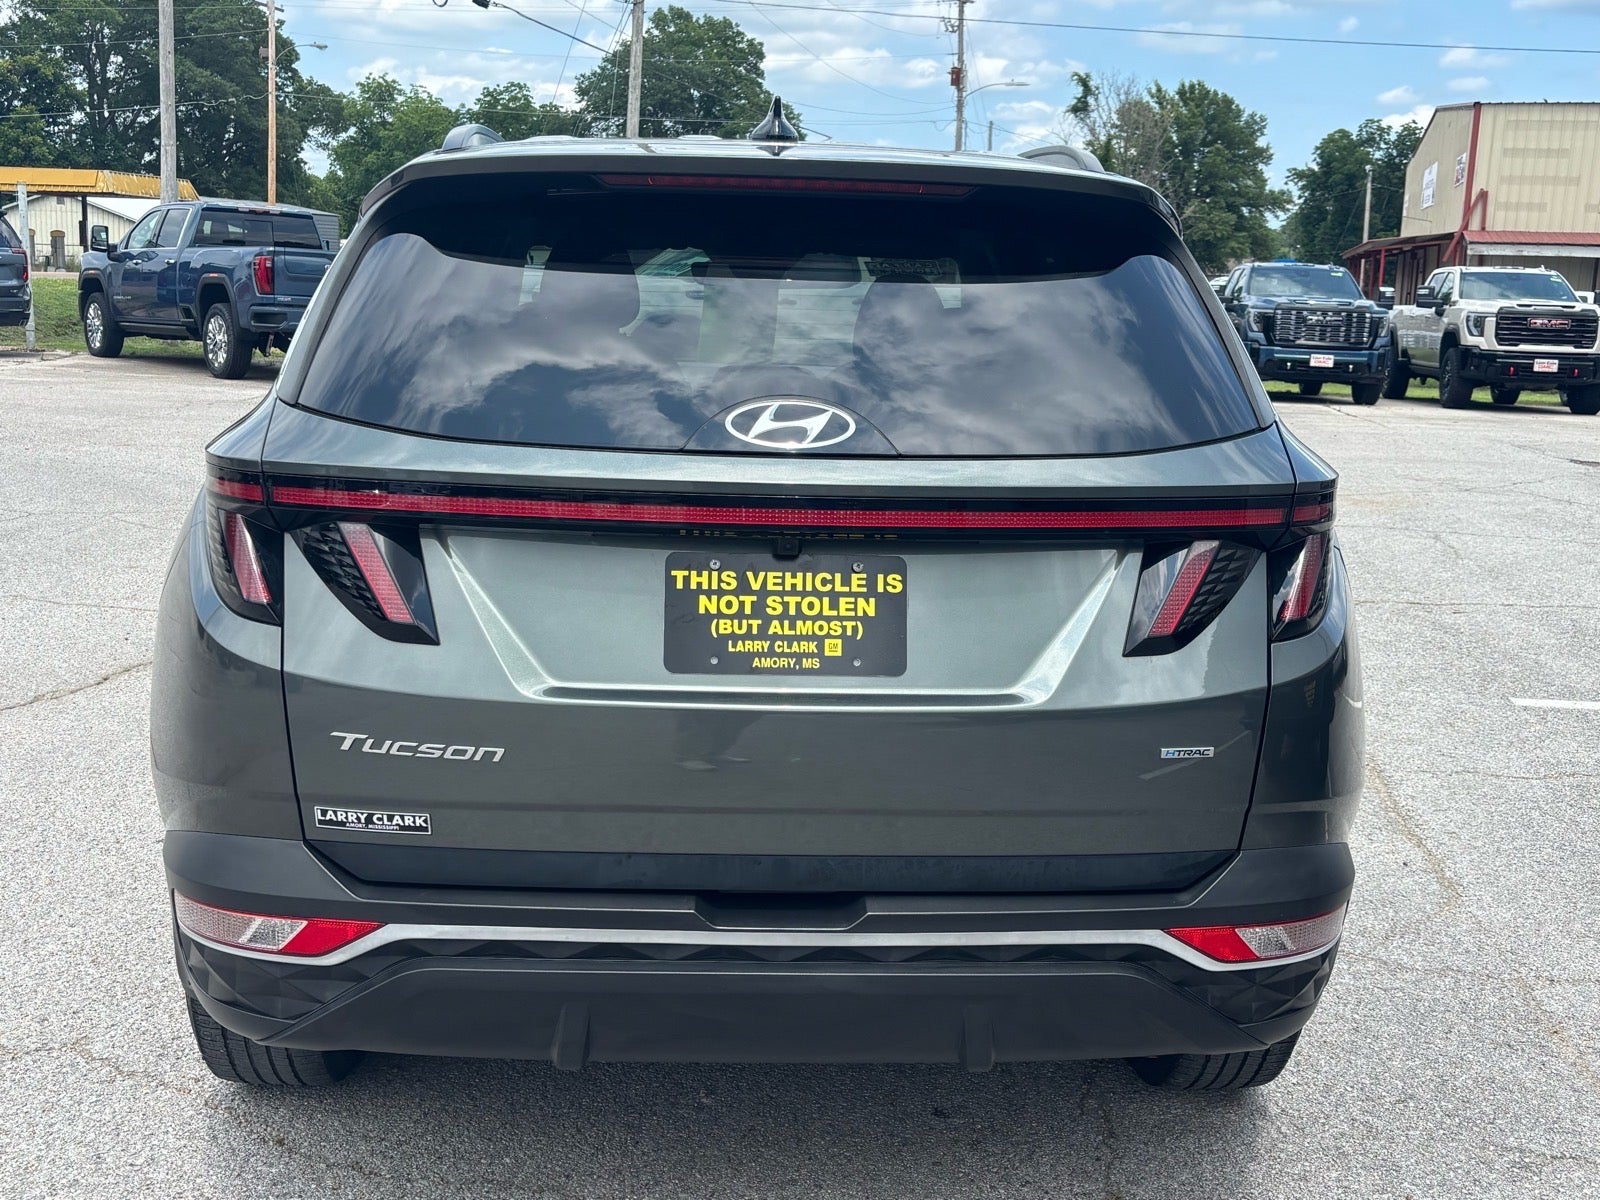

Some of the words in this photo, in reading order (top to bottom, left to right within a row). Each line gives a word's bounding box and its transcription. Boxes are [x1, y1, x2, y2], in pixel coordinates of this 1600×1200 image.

[1530, 319, 1569, 328] GMC
[671, 570, 738, 591] THIS
[745, 571, 868, 593] VEHICLE
[876, 573, 903, 594] IS
[698, 595, 758, 615] NOT
[765, 596, 876, 617] STOLEN
[710, 618, 762, 639] (BUT
[767, 620, 864, 640] ALMOST)
[728, 640, 770, 653] LARRY
[774, 641, 818, 654] CLARK
[828, 642, 839, 650] GM
[752, 657, 799, 670] AMORY,
[802, 658, 820, 669] MS
[1165, 748, 1211, 757] HTRAC
[316, 809, 369, 824] LARRY
[372, 814, 429, 827] CLARK
